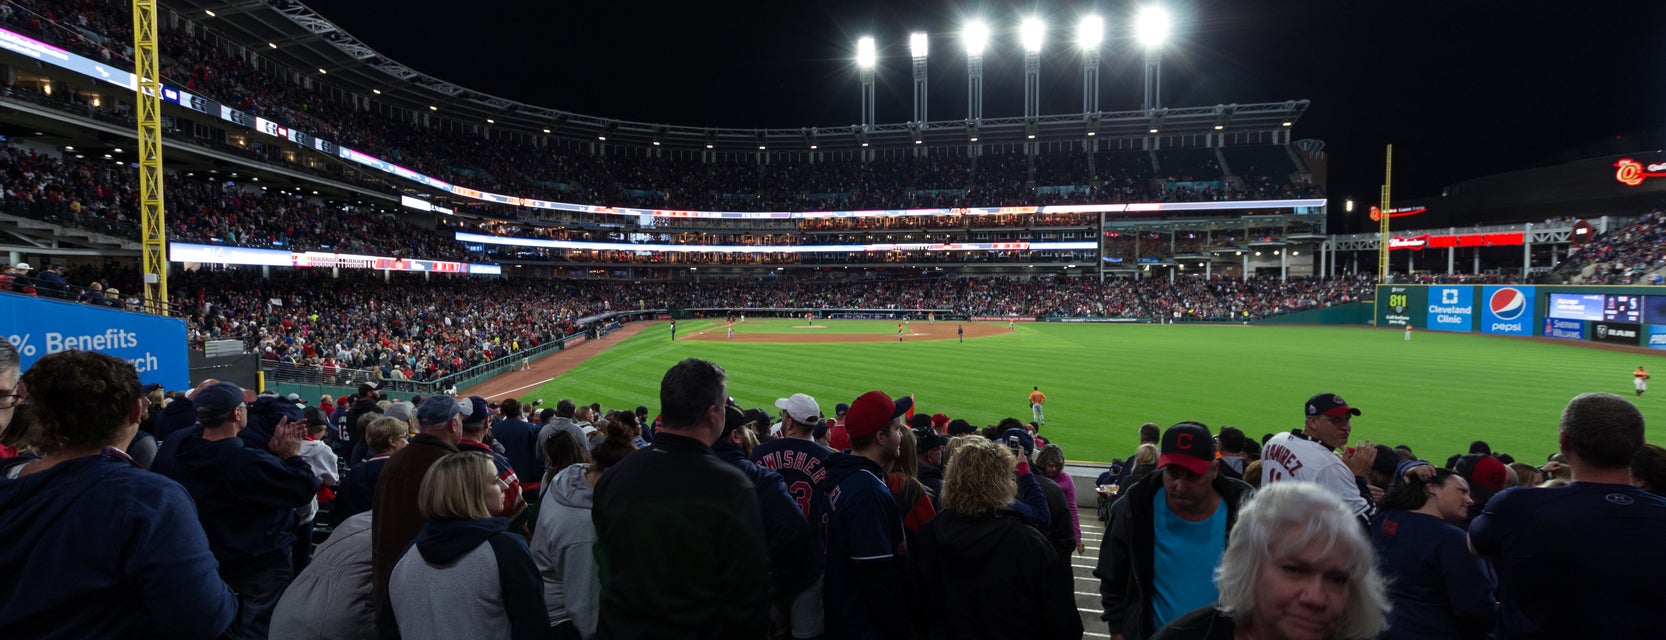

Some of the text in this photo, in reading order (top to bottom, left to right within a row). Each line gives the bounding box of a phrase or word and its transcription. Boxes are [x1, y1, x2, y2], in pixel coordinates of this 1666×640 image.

[1389, 294, 1407, 308] 811
[1428, 304, 1472, 315] Cleveland
[1436, 314, 1462, 324] Clinic
[1491, 321, 1522, 333] pepsi
[1607, 328, 1637, 338] RAM
[46, 329, 137, 354] Benefits
[1176, 433, 1194, 449] C
